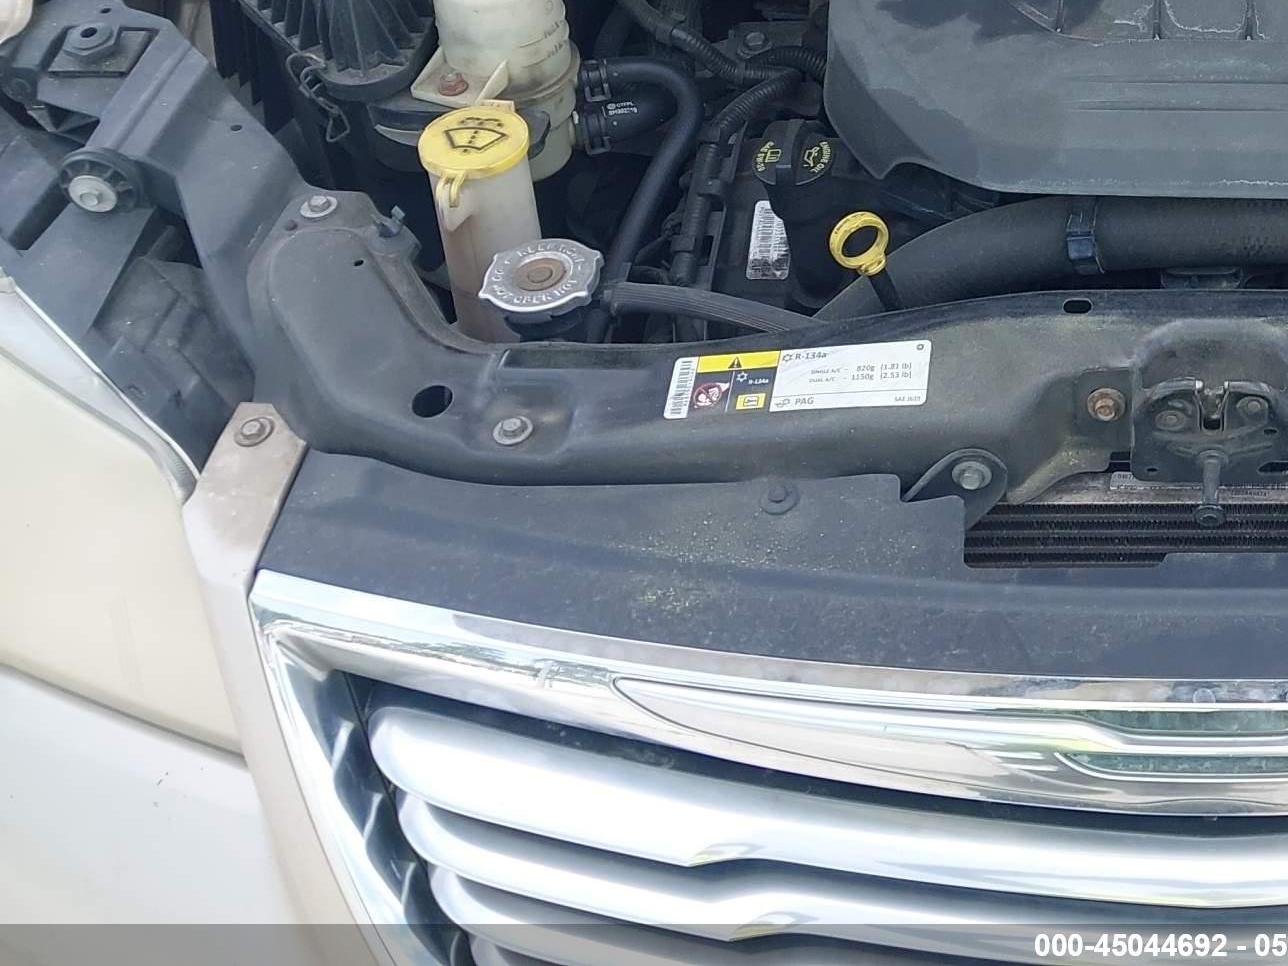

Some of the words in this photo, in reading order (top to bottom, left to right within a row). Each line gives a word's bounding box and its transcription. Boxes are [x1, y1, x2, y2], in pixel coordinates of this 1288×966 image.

[819, 141, 832, 164] ENGINE
[810, 163, 825, 173] OIL
[795, 352, 828, 361] R-134a
[856, 364, 876, 373] 820g
[851, 373, 875, 381] 1150g
[795, 397, 815, 405] PAG
